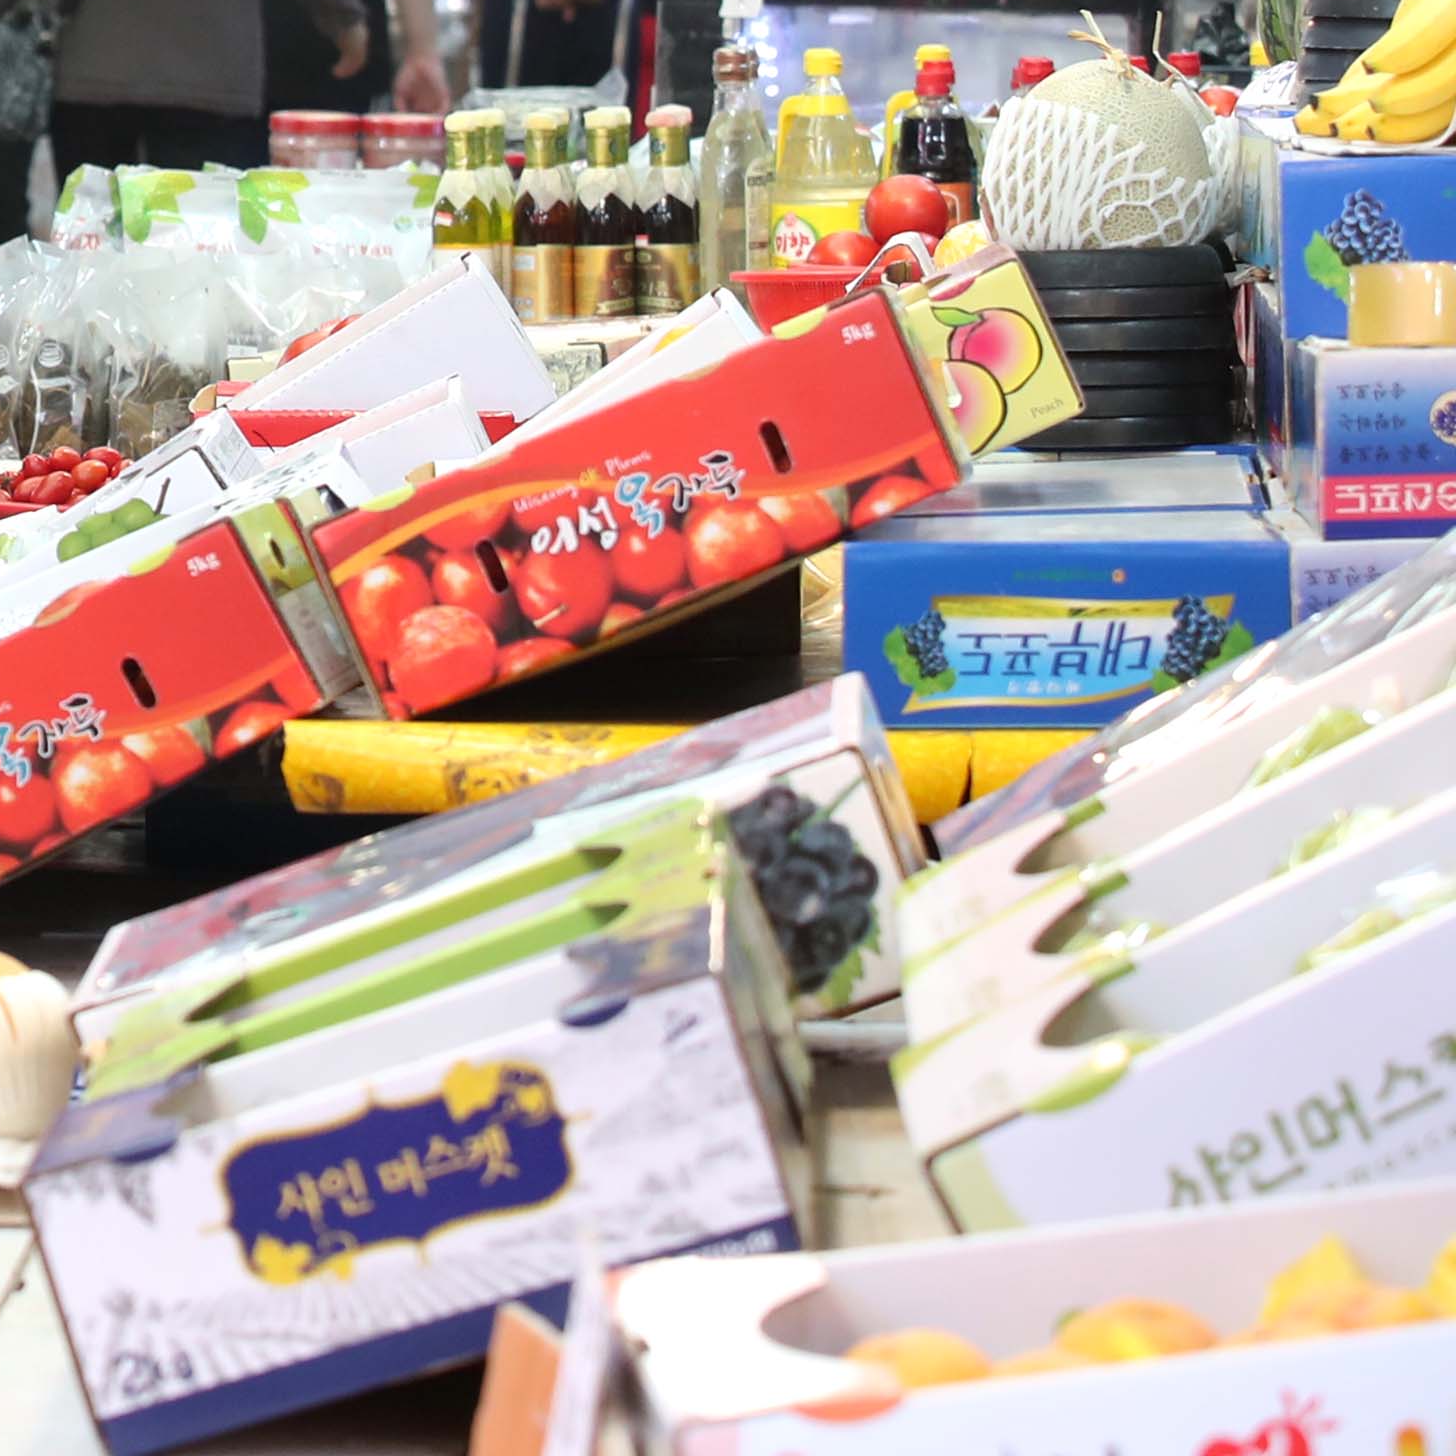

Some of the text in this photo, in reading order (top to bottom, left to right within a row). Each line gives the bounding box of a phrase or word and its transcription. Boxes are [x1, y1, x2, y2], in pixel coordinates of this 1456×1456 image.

[1030, 397, 1064, 418] Peach
[957, 621, 1153, 678] 대부포도
[275, 1156, 375, 1222] 샤인
